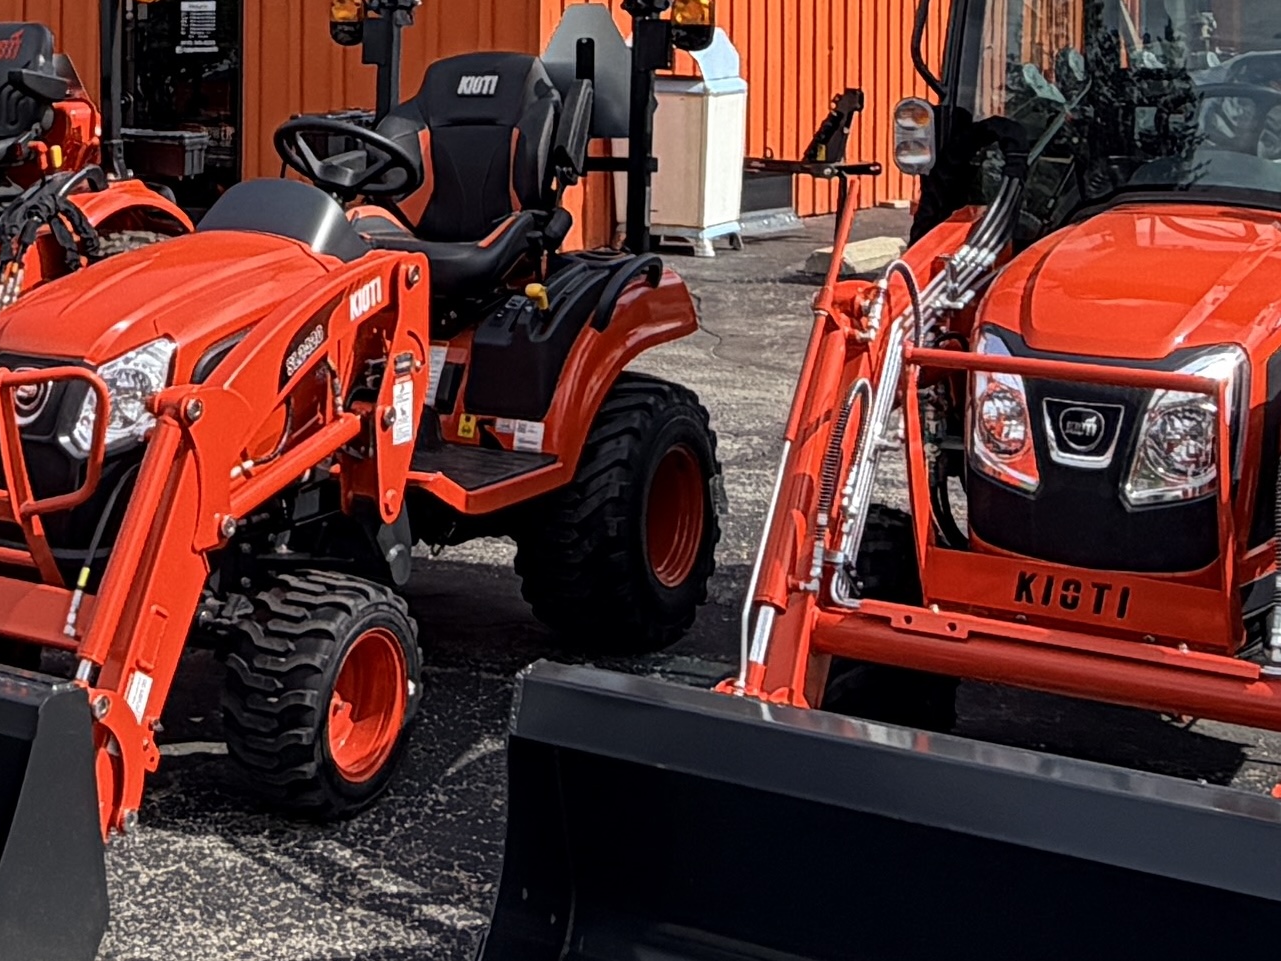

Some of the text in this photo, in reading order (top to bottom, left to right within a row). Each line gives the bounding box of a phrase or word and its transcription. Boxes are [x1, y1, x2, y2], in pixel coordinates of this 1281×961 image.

[457, 75, 499, 95] KIOTI
[349, 275, 382, 322] KIOTI
[1014, 570, 1131, 619] KIOTI
